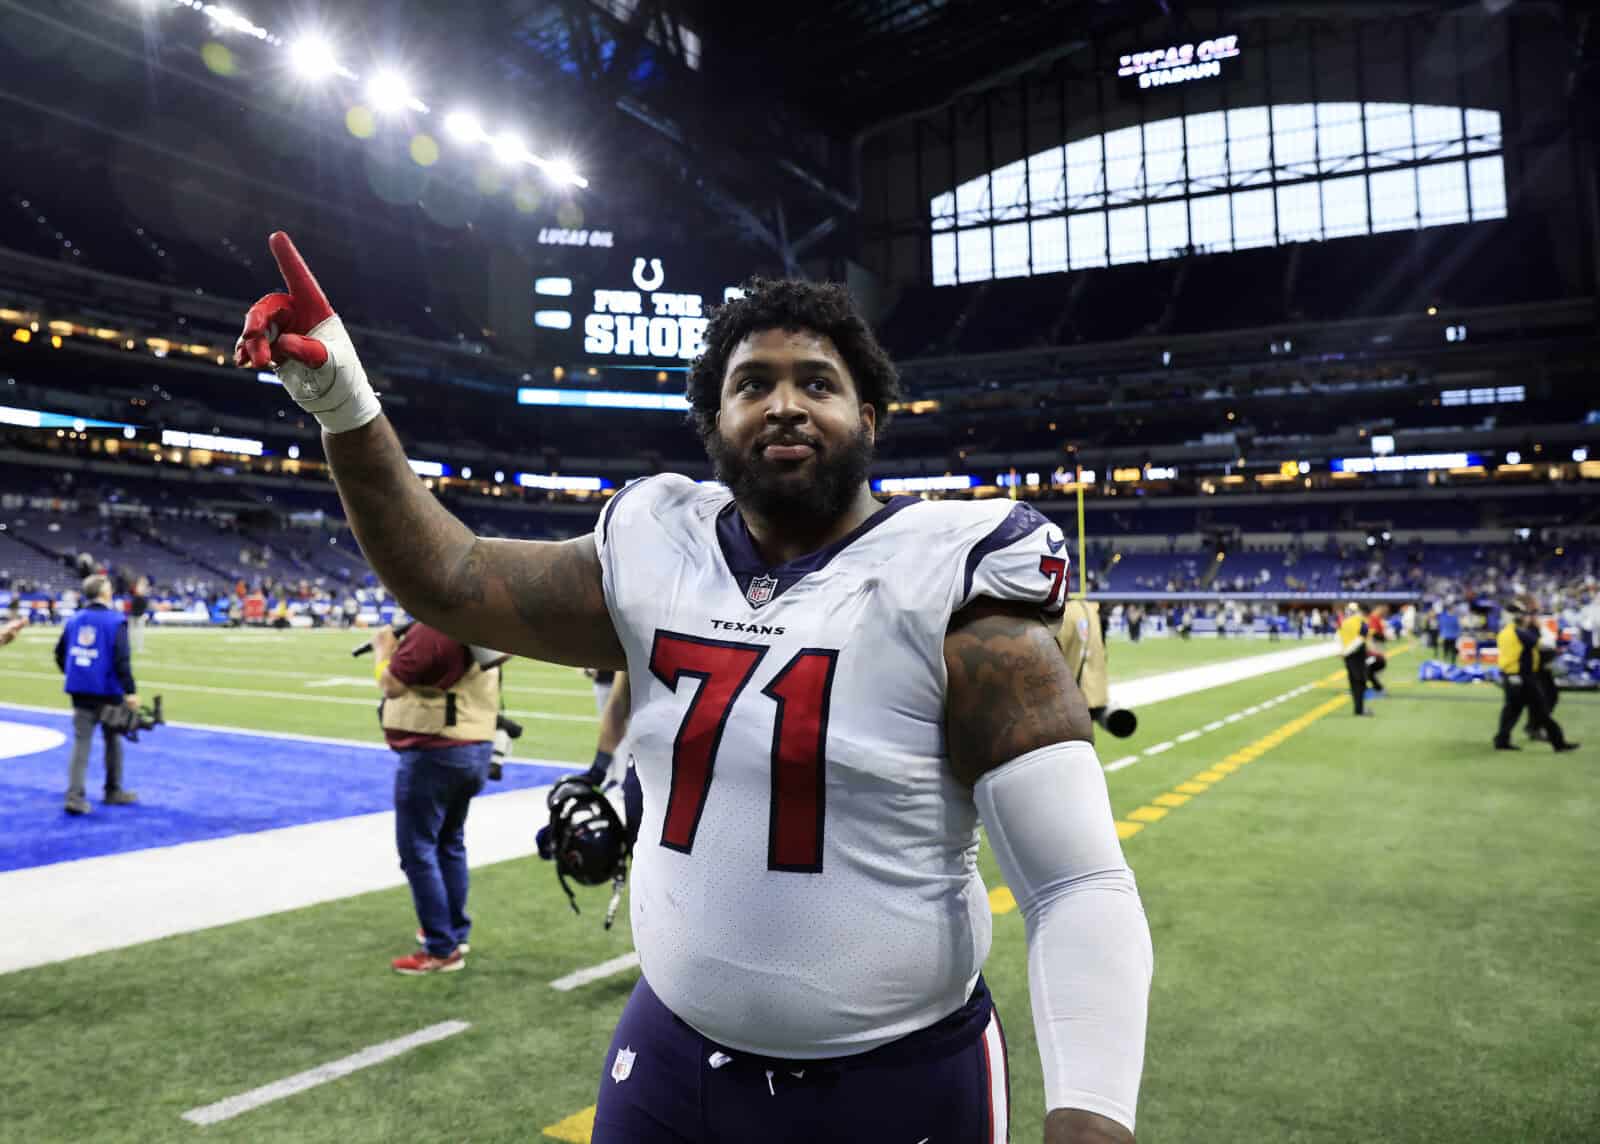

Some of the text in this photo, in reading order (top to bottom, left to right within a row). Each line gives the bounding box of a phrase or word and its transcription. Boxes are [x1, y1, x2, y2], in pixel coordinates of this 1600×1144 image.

[1138, 60, 1221, 88] STADIUM
[537, 228, 614, 248] LUCAS OIL
[593, 289, 642, 314] FOR
[651, 292, 702, 317] THE
[711, 619, 786, 635] TEXANS
[648, 628, 840, 873] 71
